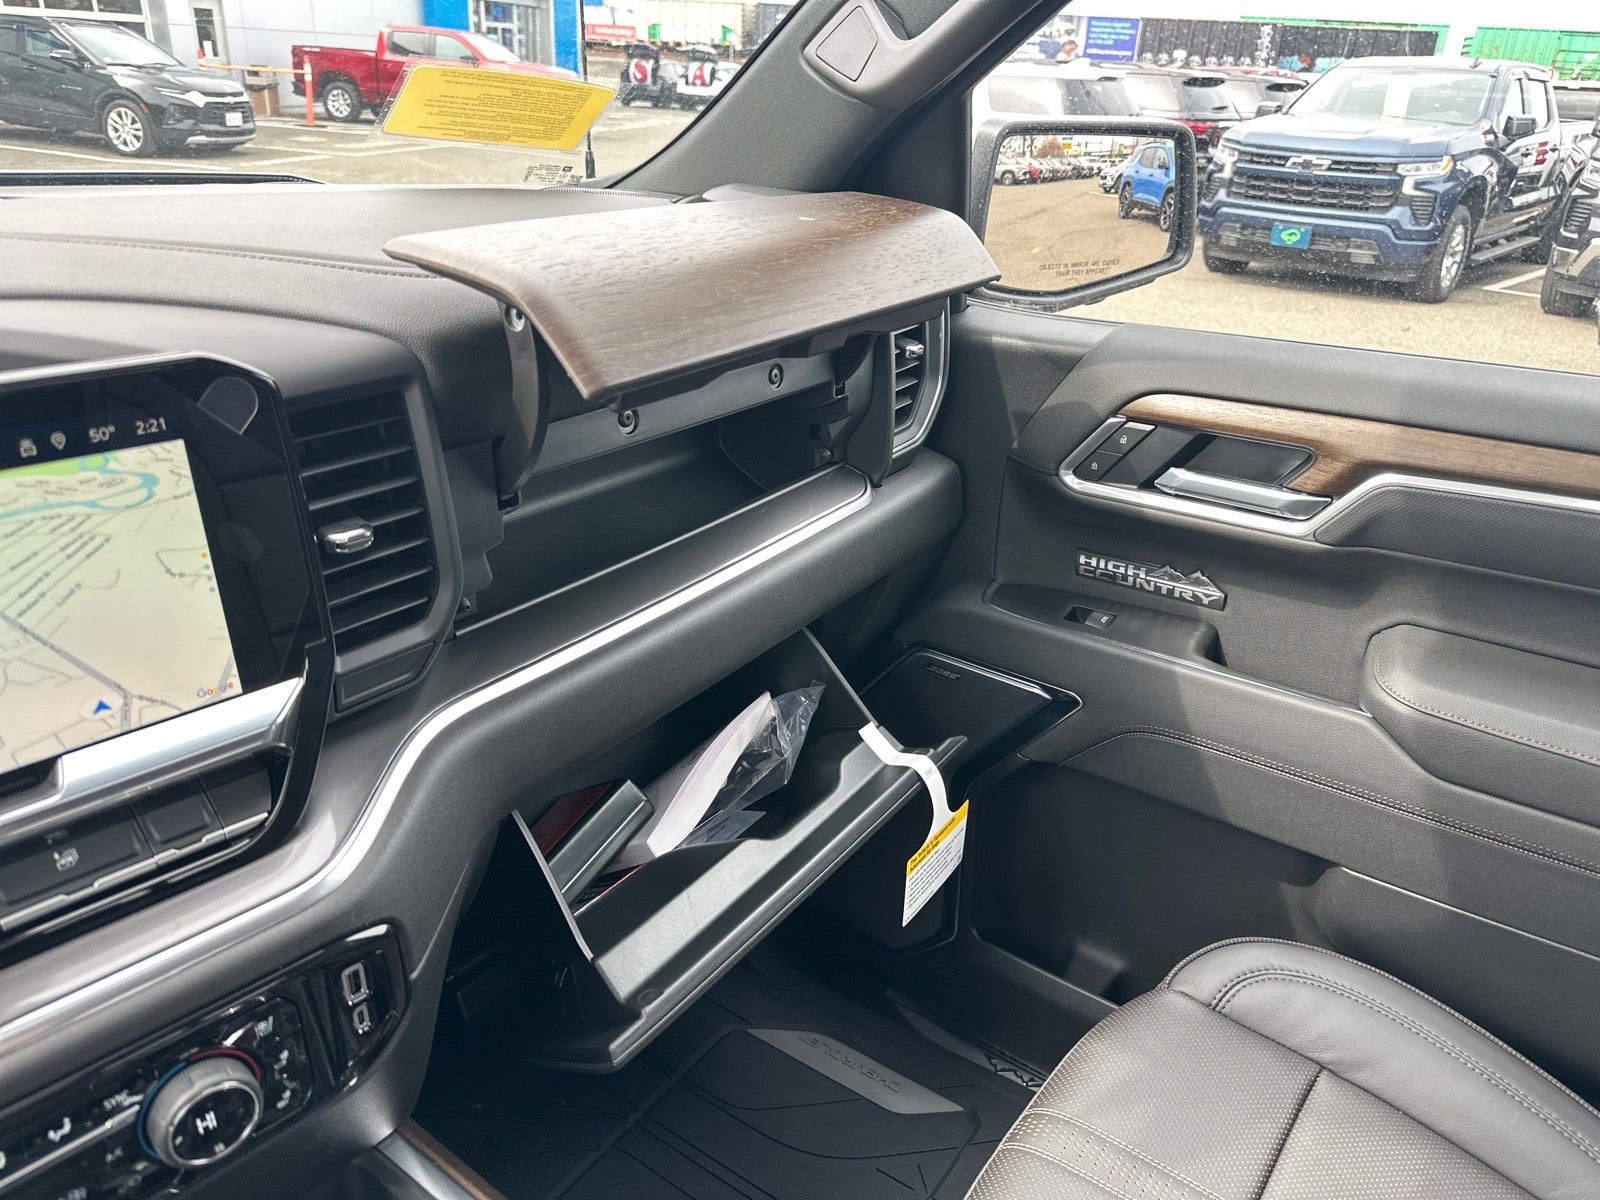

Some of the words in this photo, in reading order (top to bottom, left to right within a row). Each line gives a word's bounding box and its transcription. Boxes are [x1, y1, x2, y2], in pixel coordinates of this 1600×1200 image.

[633, 59, 649, 84] S
[691, 63, 712, 87] A
[1039, 263, 1061, 271] OBJECTS
[135, 417, 167, 435] 2:21
[1079, 554, 1147, 579] HIGH
[1078, 565, 1220, 605] COUNTRY
[196, 682, 235, 698] Google
[798, 1037, 902, 1093] CHEVROLET
[195, 1110, 217, 1135] HI
